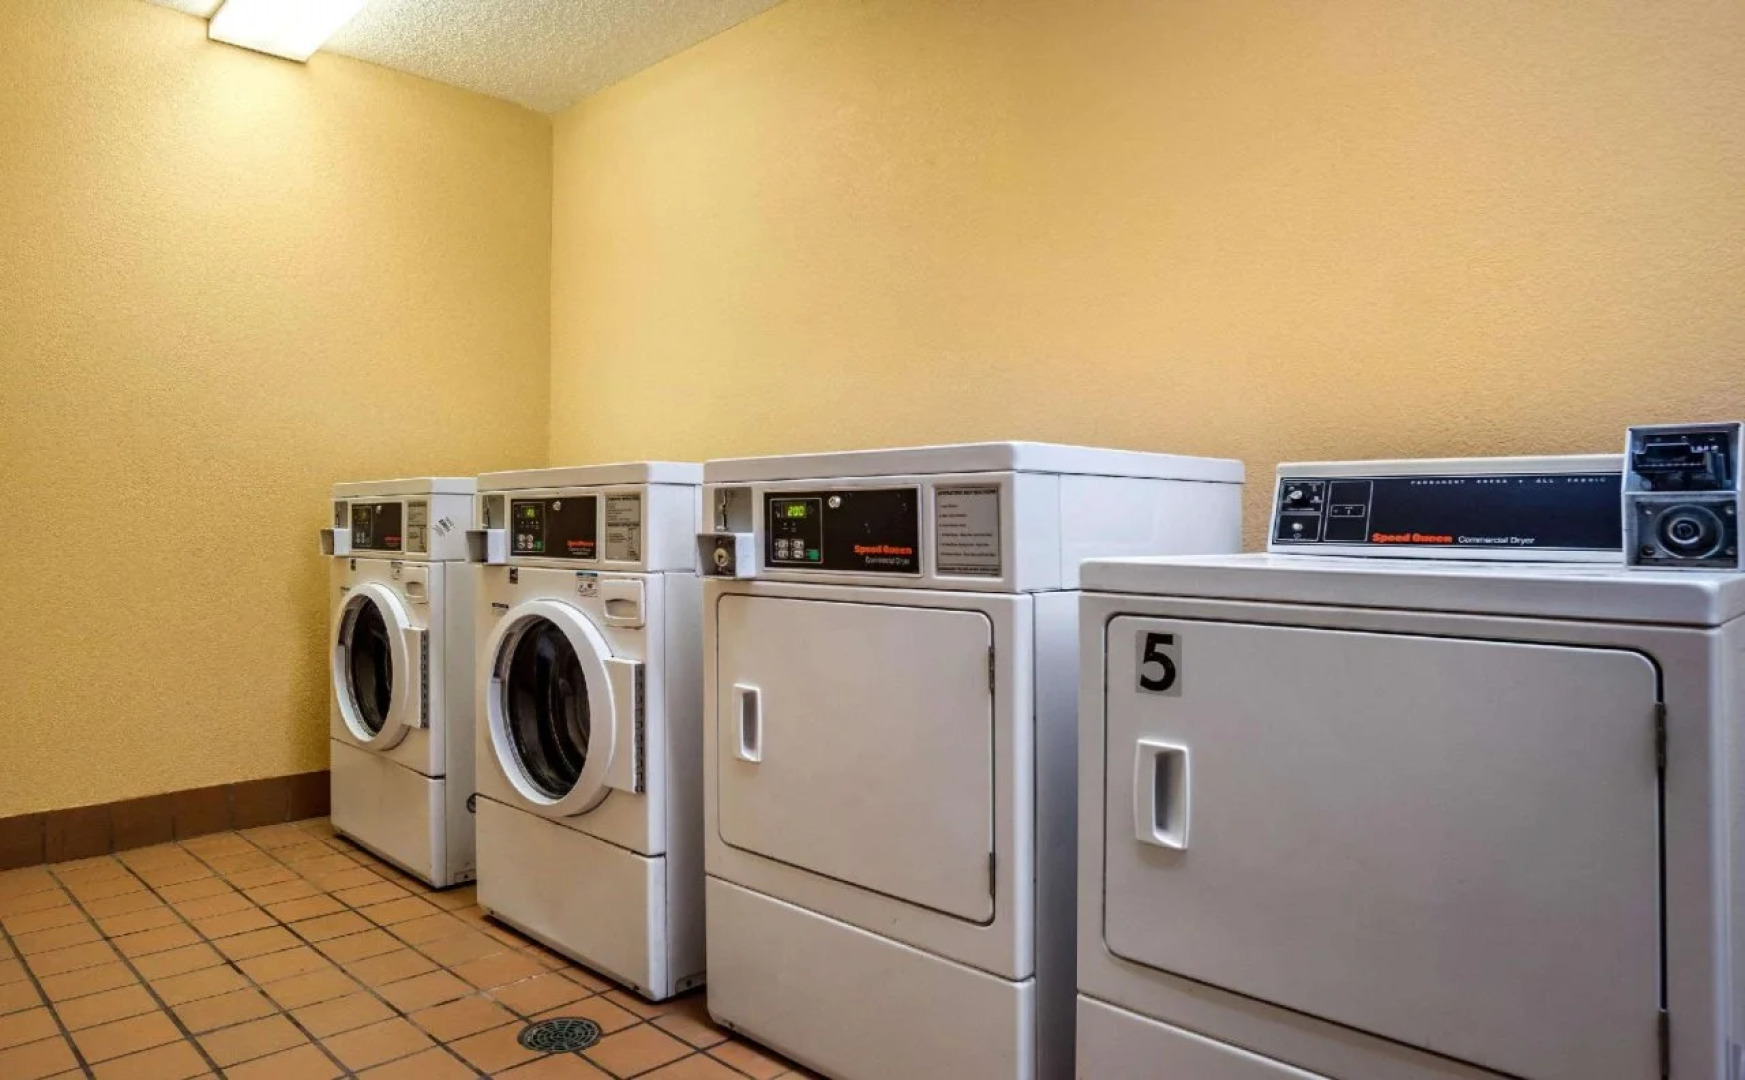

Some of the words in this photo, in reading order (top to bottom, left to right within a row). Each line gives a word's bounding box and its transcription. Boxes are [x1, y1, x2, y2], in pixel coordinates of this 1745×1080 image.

[1373, 532, 1410, 543] Speed
[1412, 532, 1453, 544] Queen
[1458, 535, 1509, 544] Commercial
[1510, 536, 1535, 545] Dryer
[854, 544, 882, 555] Speed
[882, 545, 912, 555] Queen
[1140, 633, 1175, 691] 5
